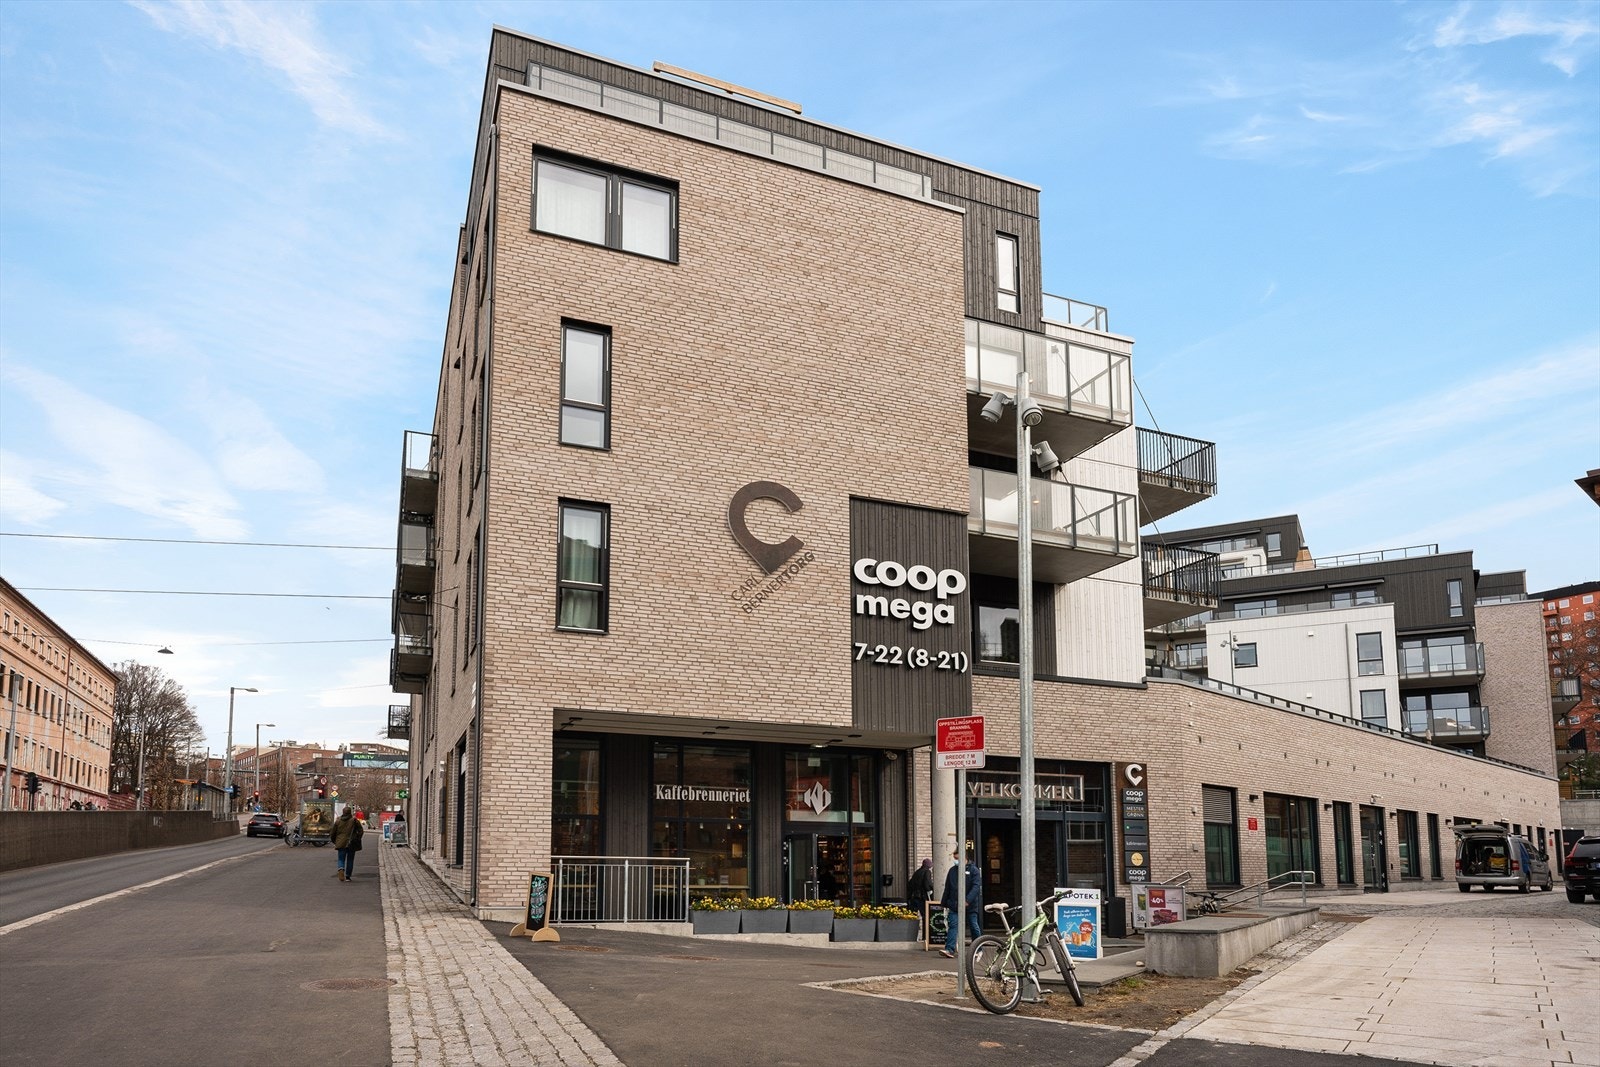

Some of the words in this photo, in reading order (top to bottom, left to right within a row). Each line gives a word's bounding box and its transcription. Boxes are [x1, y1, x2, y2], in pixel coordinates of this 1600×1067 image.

[731, 575, 763, 601] CARL
[741, 552, 815, 614] BERNERTORG
[854, 558, 967, 599] coop
[856, 594, 955, 630] mega
[855, 642, 903, 665] 7-22
[907, 646, 968, 673] (8-21)
[938, 719, 983, 727] OPPSTILLINGSPLASS
[655, 784, 751, 803] Kaffebrenneriet
[967, 781, 1075, 800] VELKOMEN
